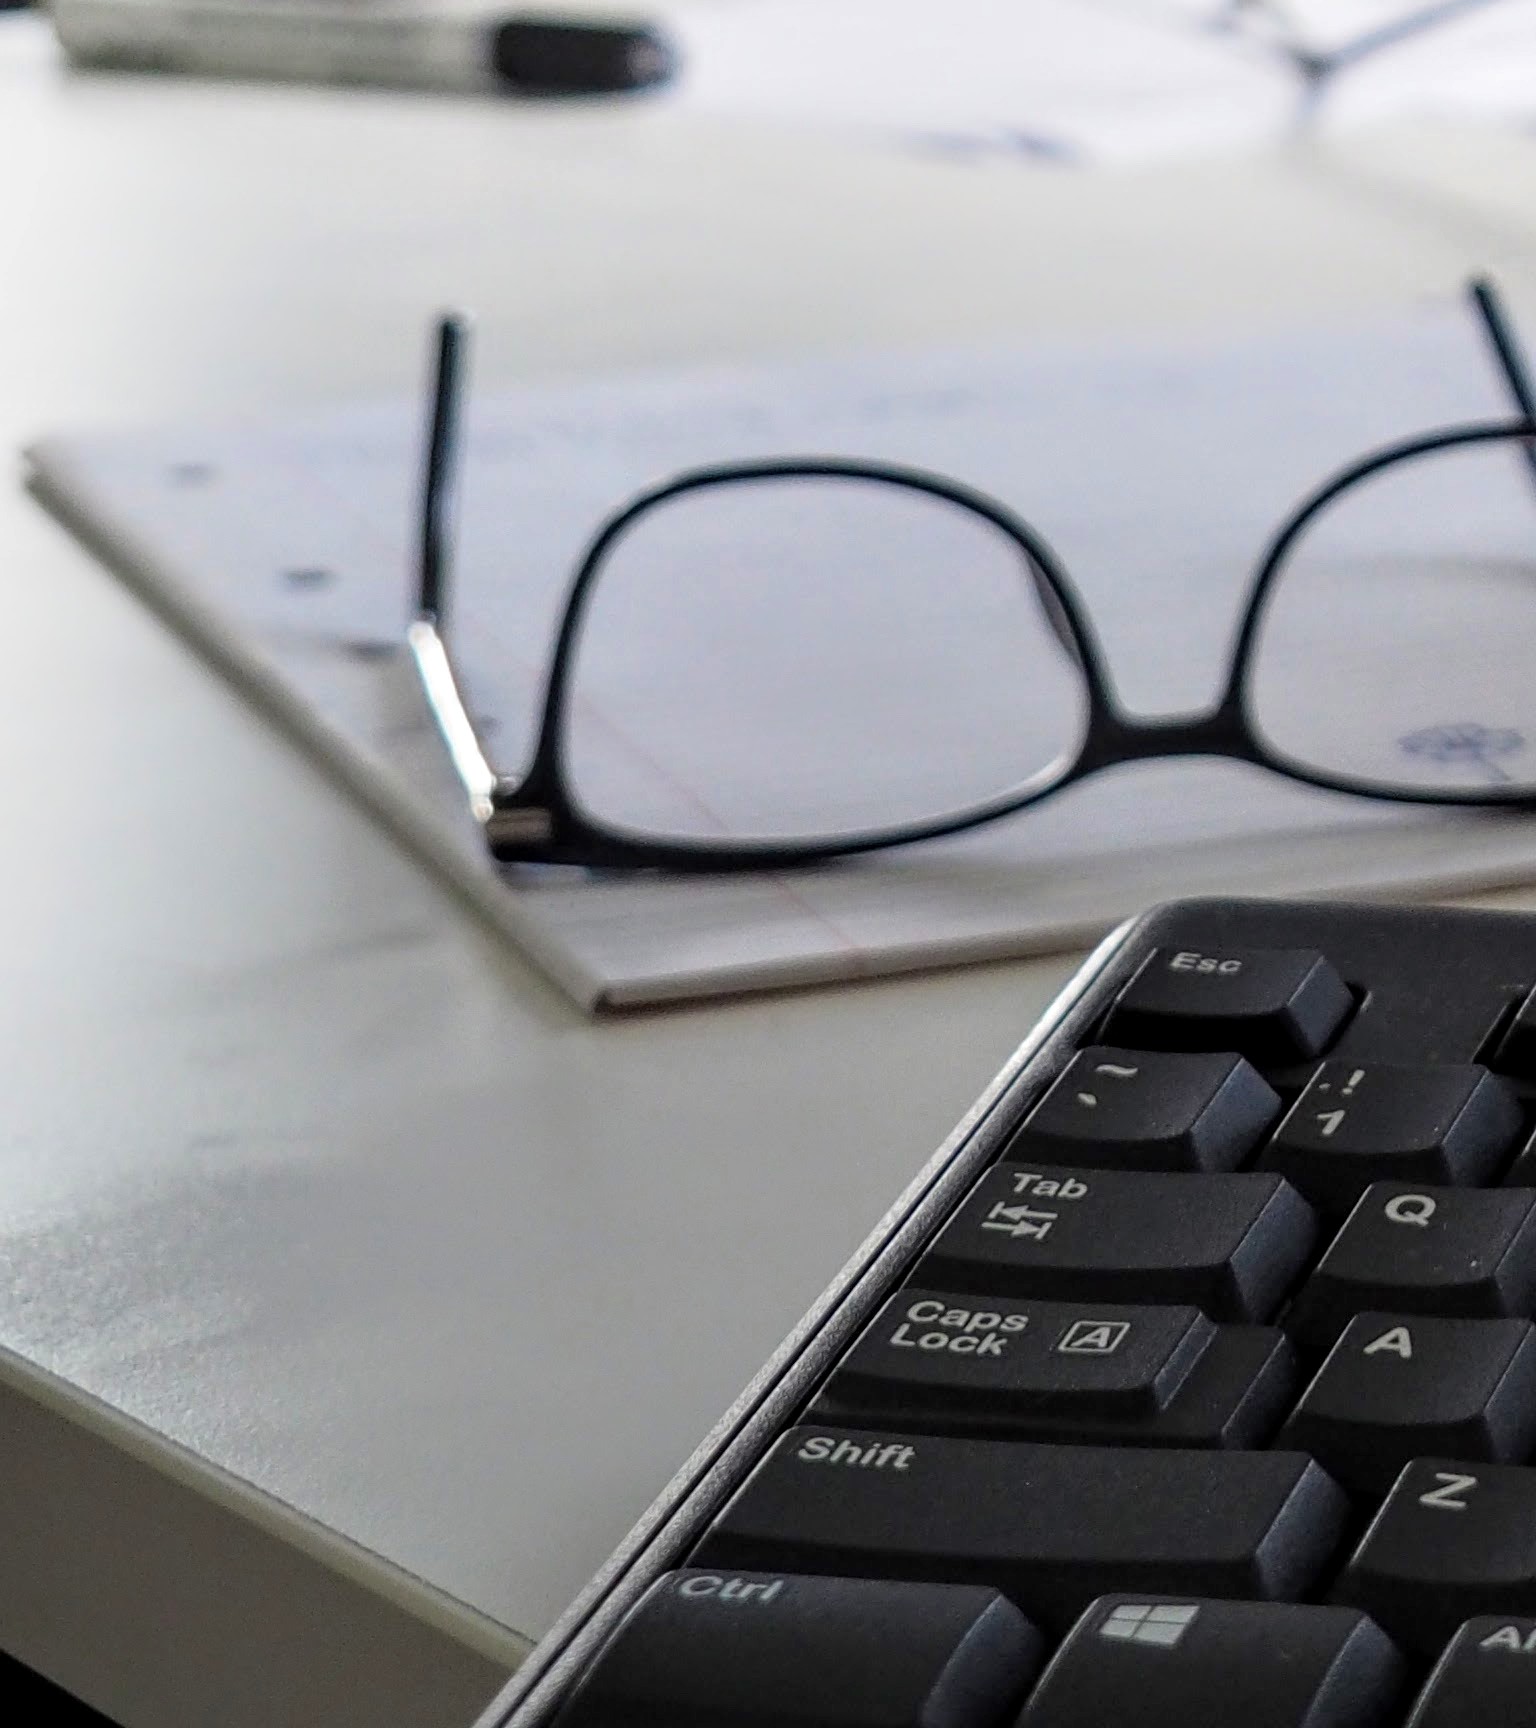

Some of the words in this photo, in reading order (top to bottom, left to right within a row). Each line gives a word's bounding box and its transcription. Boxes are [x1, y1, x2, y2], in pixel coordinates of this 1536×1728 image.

[1170, 952, 1243, 973] Esc
[1341, 1070, 1364, 1096] !
[1316, 1109, 1345, 1135] 1
[1011, 1173, 1088, 1201] Tab
[1386, 1194, 1437, 1226] Q
[906, 1300, 1029, 1338] Caps
[889, 1325, 1010, 1359] Lock
[1364, 1327, 1413, 1359] A
[798, 1437, 915, 1471] Shift
[1420, 1474, 1477, 1510] Z
[678, 1575, 785, 1604] Ctrl
